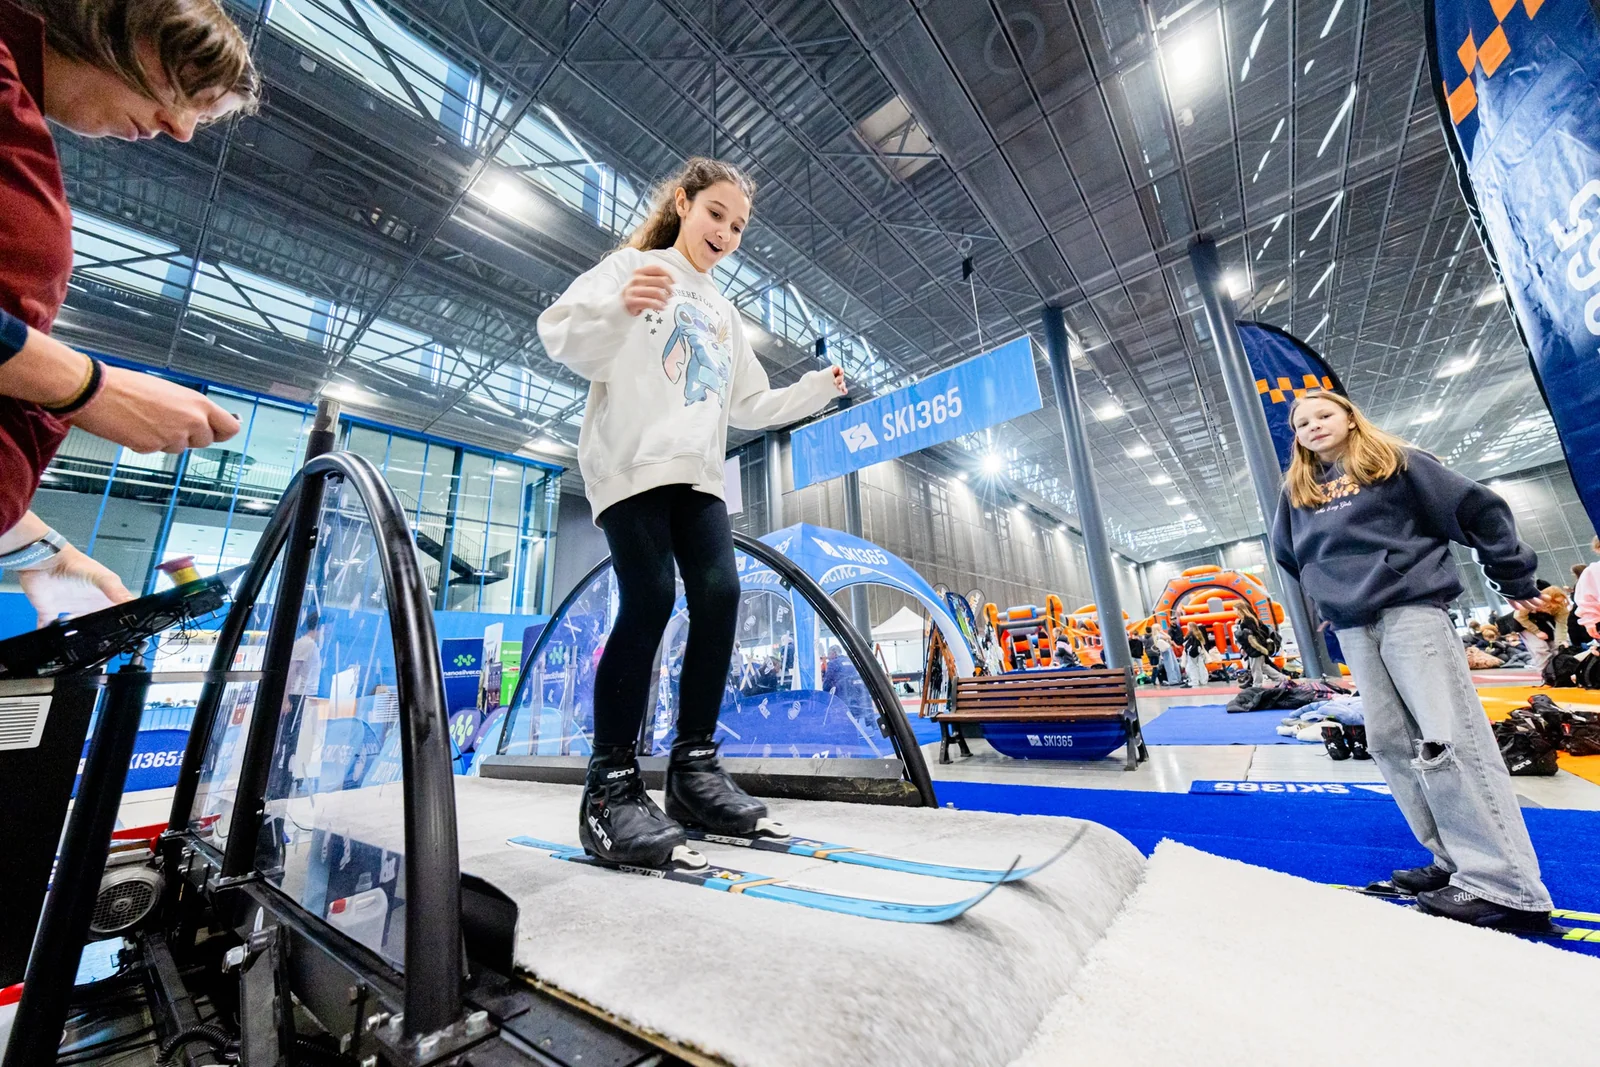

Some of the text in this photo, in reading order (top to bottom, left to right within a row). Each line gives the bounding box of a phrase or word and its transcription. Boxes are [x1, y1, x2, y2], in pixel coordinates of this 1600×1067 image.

[882, 386, 962, 441] SKI365
[838, 545, 889, 566] SKI365
[1043, 734, 1073, 747] SKI365
[1214, 782, 1349, 794] SKI365
[619, 864, 666, 879] SPORTEN
